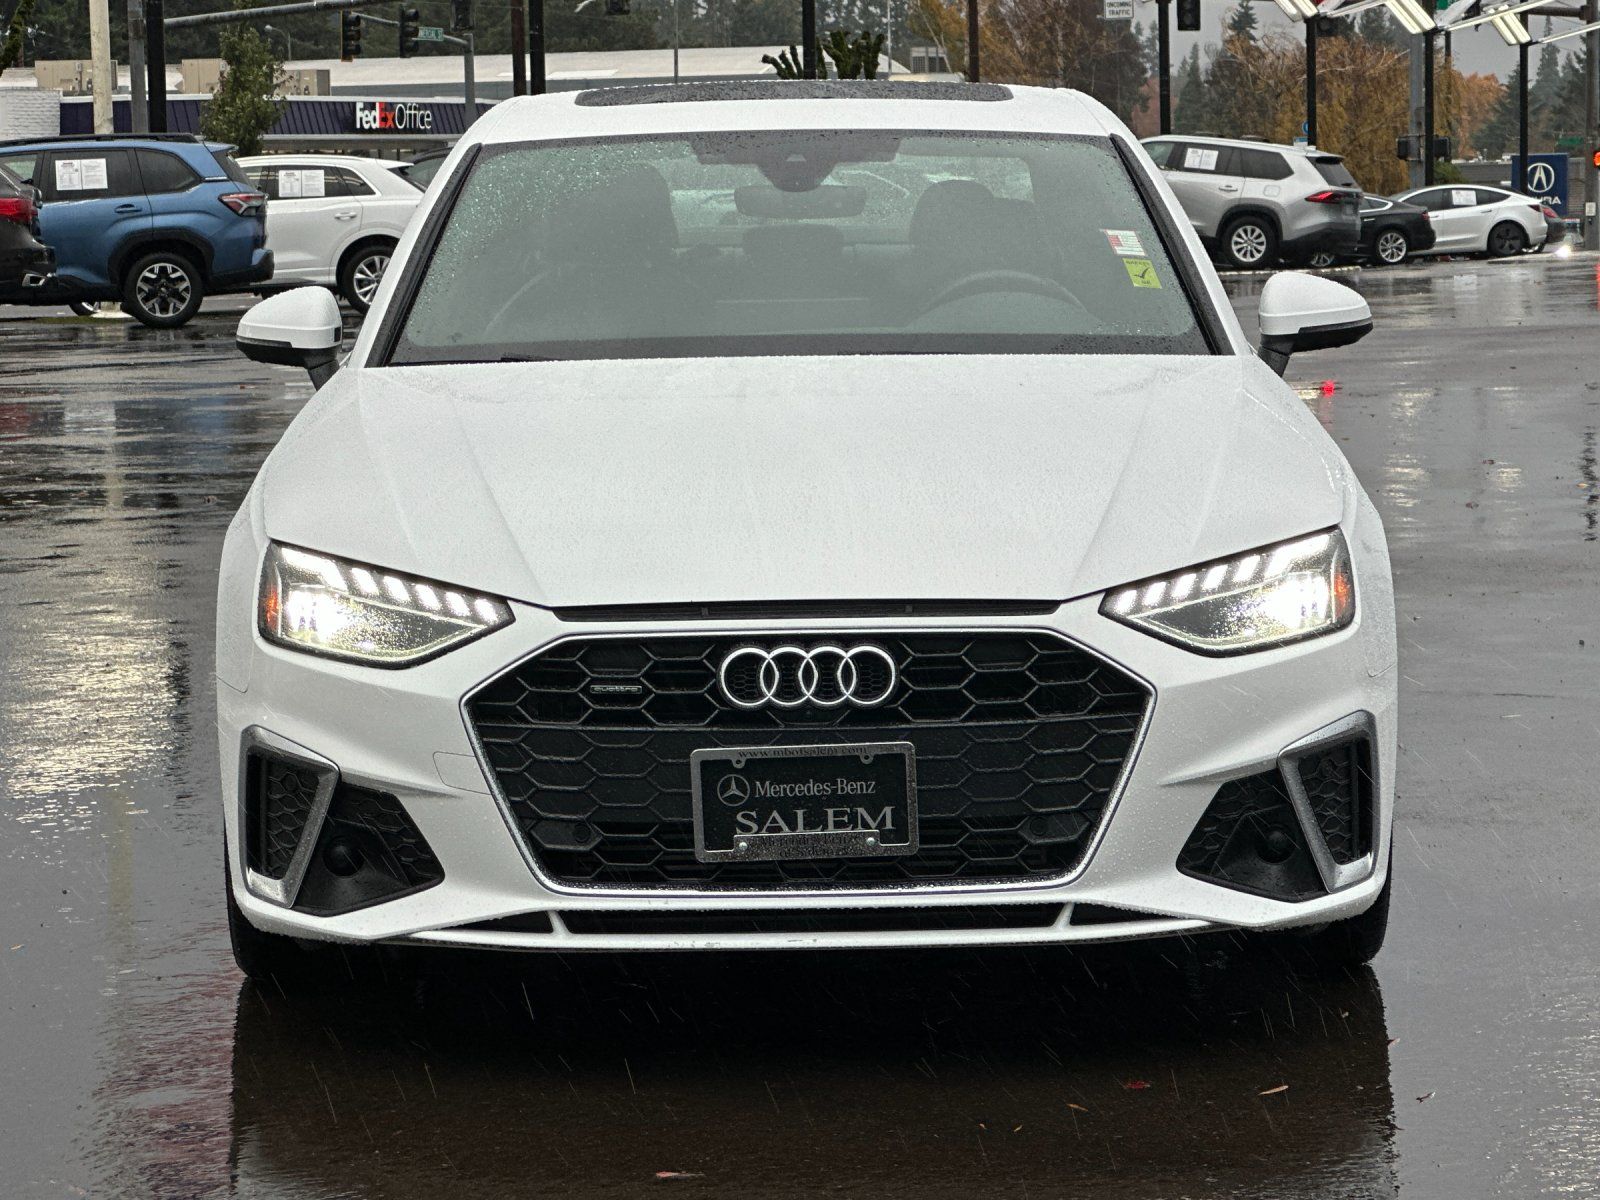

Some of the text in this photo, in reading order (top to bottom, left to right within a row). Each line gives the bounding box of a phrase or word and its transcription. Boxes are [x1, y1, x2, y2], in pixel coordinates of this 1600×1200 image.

[356, 102, 432, 129] FedEx Office
[754, 778, 876, 797] Mercedes-Benz
[735, 806, 896, 834] SALEM
